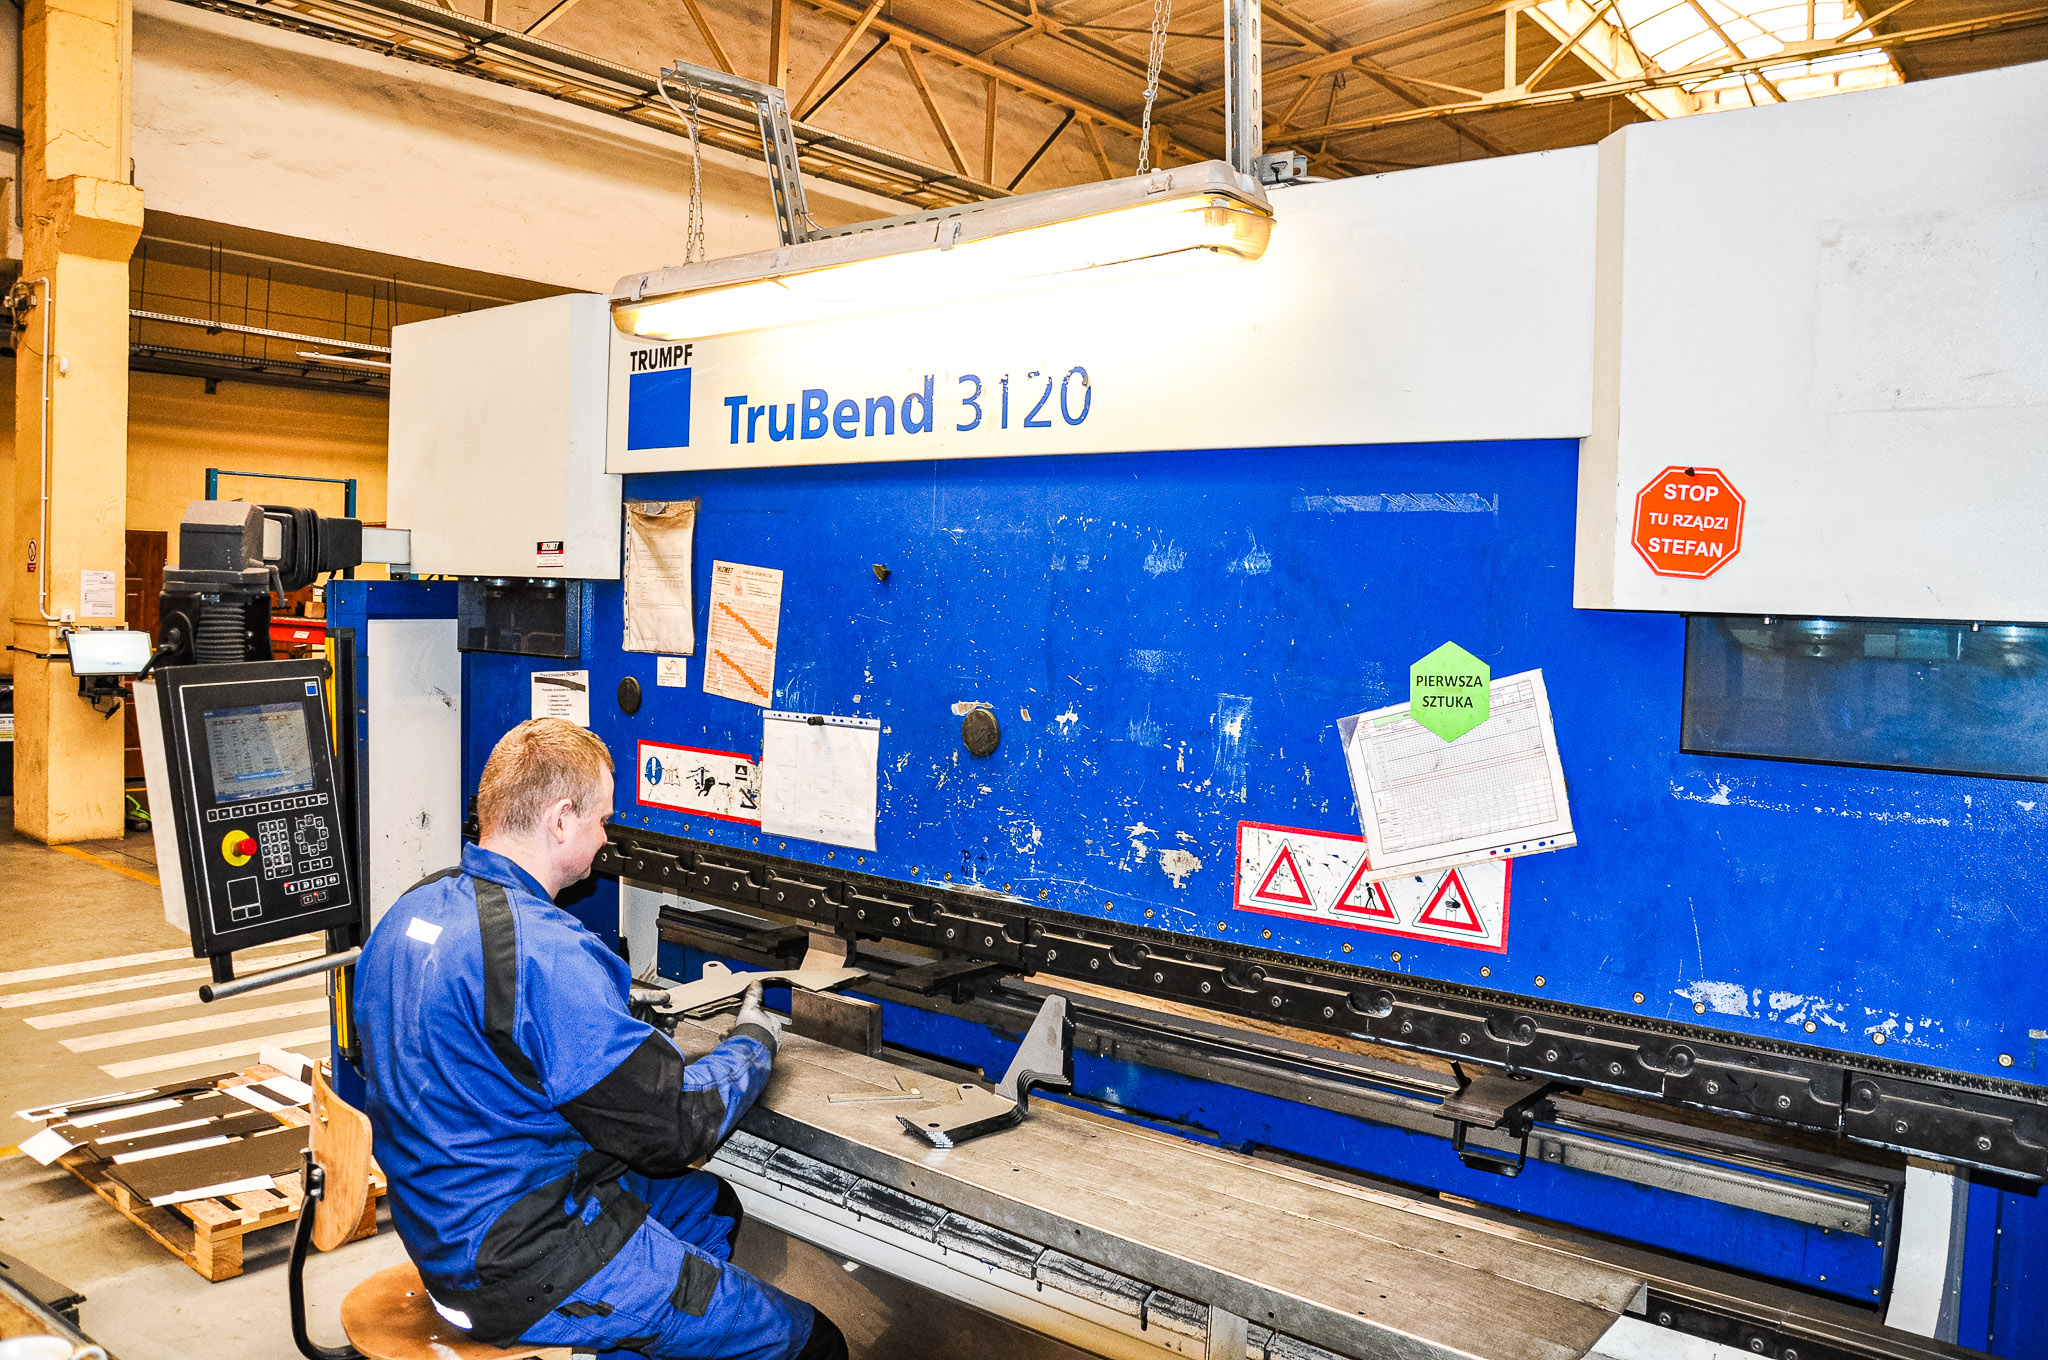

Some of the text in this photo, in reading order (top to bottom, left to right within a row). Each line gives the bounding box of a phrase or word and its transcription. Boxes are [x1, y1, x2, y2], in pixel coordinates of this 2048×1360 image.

[630, 343, 693, 372] TRUMPF
[723, 365, 1093, 445] TruBend 3120
[1663, 483, 1719, 502] STOP
[1648, 512, 1729, 532] TU RZĄDZI
[1647, 537, 1723, 558] STEFAN
[1415, 675, 1483, 688] PIERWSZA
[1422, 695, 1474, 709] SZTUKA
